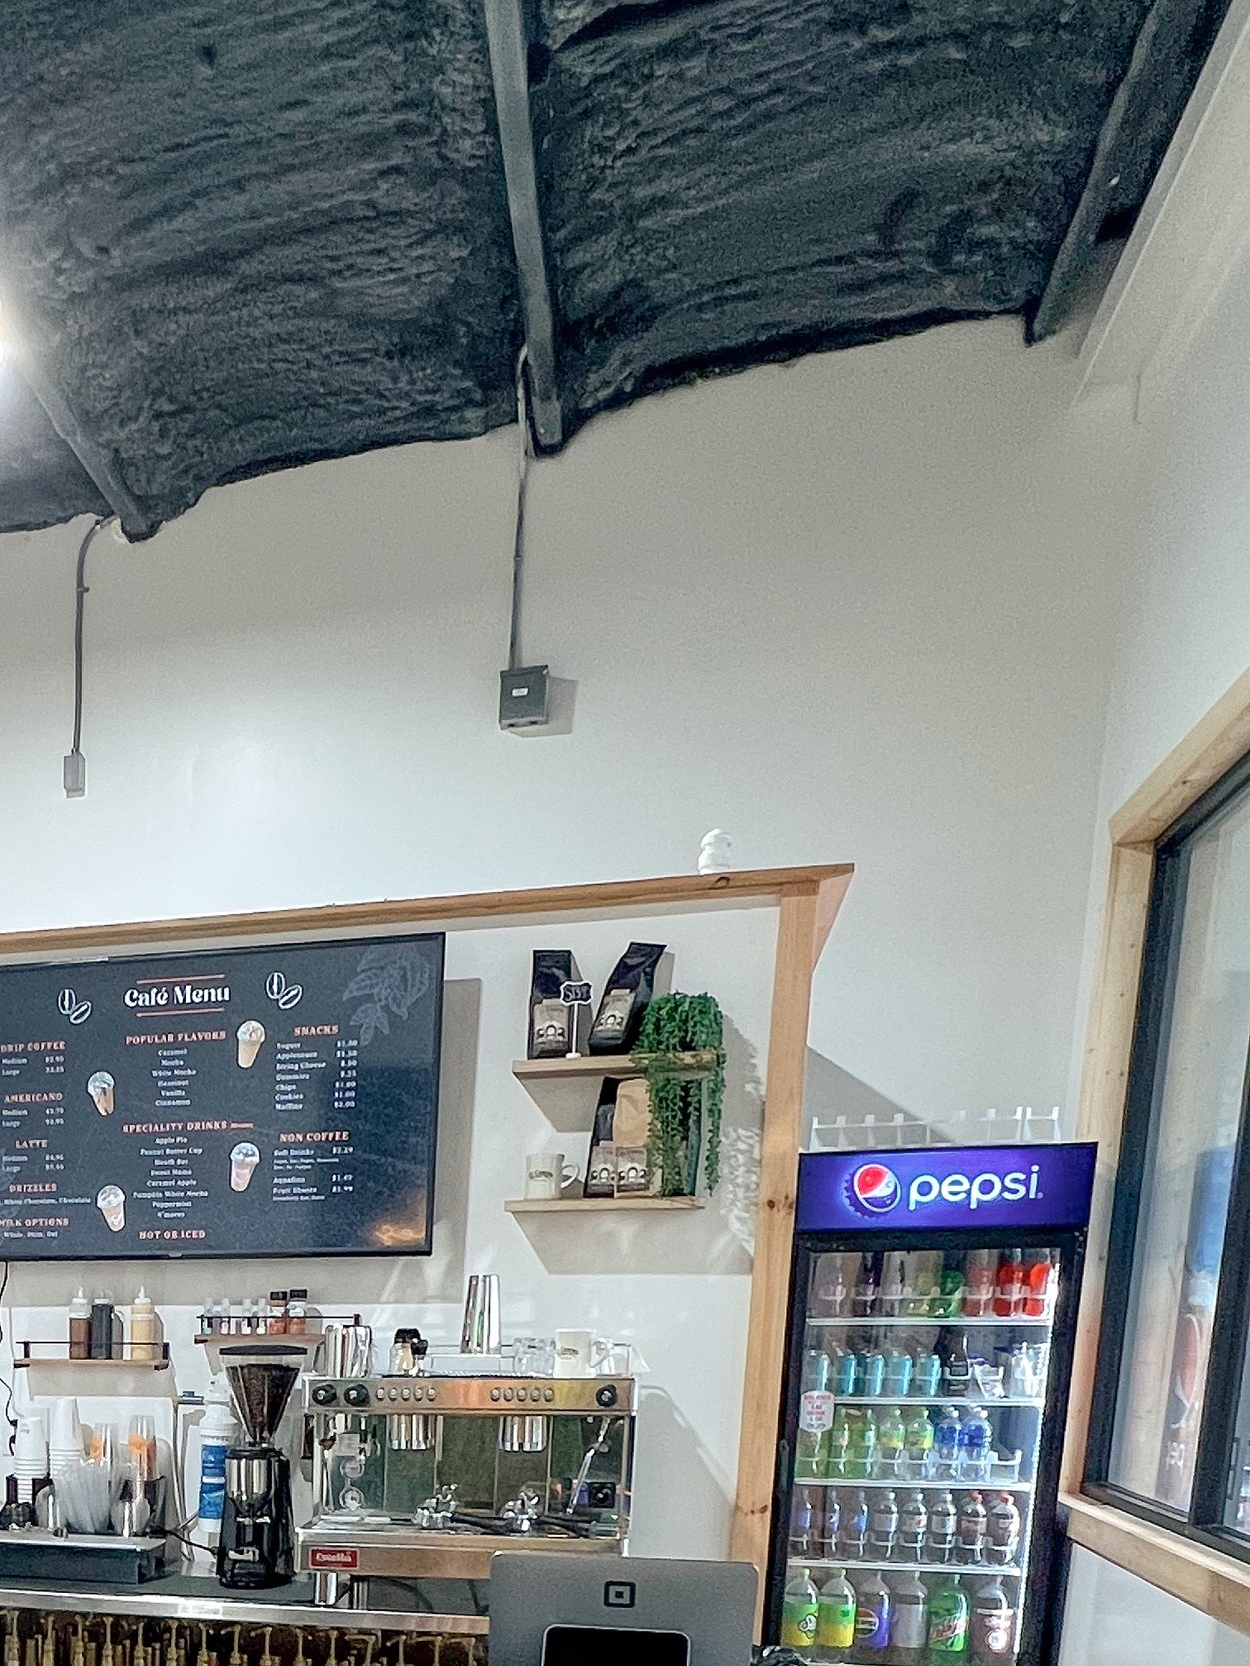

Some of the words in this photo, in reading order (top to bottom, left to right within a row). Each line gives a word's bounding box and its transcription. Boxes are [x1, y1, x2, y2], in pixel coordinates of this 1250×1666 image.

[123, 986, 169, 1008] Café
[173, 984, 231, 1005] Menu
[293, 1025, 339, 1036] SNACKS
[125, 1033, 174, 1045] POPULAR
[177, 1030, 227, 1042] FLAVORS
[0, 1043, 25, 1053] DRIP
[27, 1040, 66, 1052] COFFEE
[3, 1092, 64, 1104] AMERICANO
[122, 1122, 184, 1134] SPECIALITY
[186, 1120, 229, 1131] DRINKS
[279, 1133, 303, 1143] NON
[306, 1131, 350, 1142] COFFEE
[15, 1139, 49, 1149] LATTE
[9, 1183, 58, 1193] DRIZZLES
[907, 1164, 1040, 1212] pepsi
[24, 1217, 70, 1228] OPTIONS
[139, 1230, 162, 1240] HOT
[163, 1230, 179, 1240] OR
[181, 1229, 207, 1239] ICED
